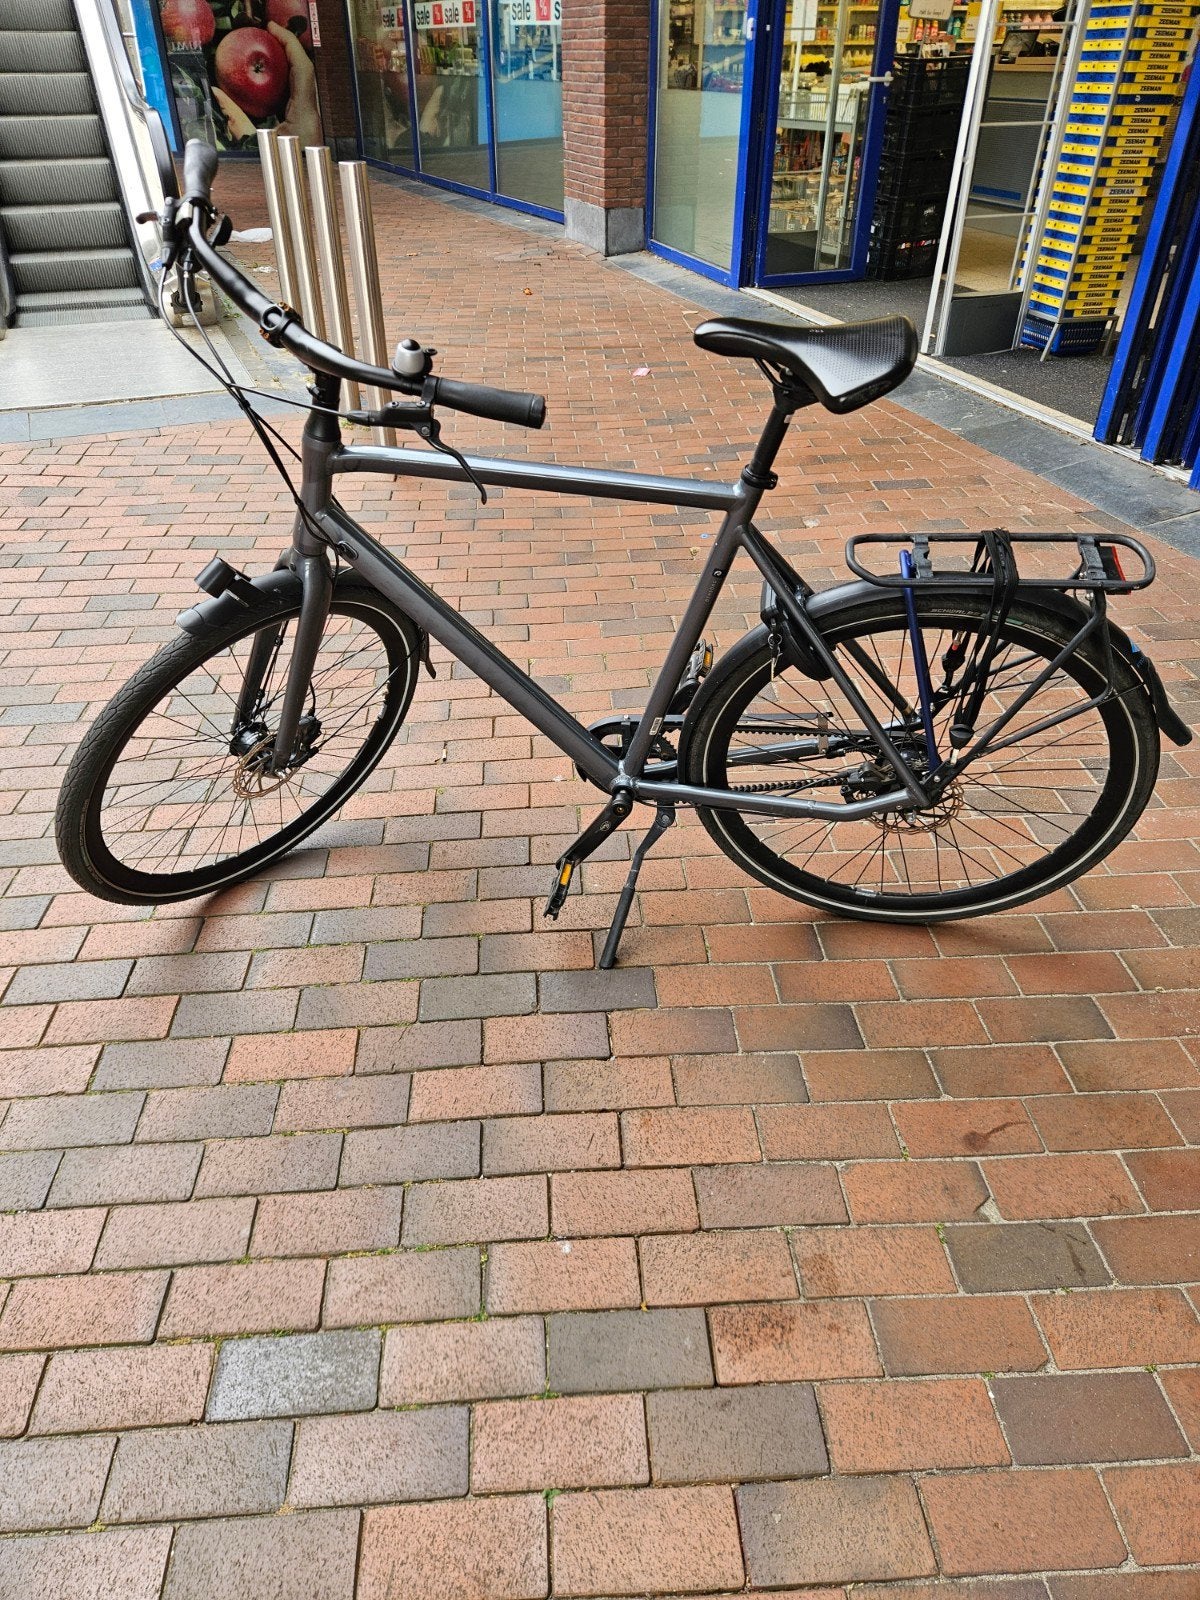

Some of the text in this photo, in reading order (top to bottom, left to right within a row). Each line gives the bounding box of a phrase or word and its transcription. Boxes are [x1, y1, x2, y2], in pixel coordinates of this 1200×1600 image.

[383, 10, 395, 28] sale
[417, 5, 430, 25] sale
[445, 2, 459, 24] sale
[512, 0, 531, 20] sale
